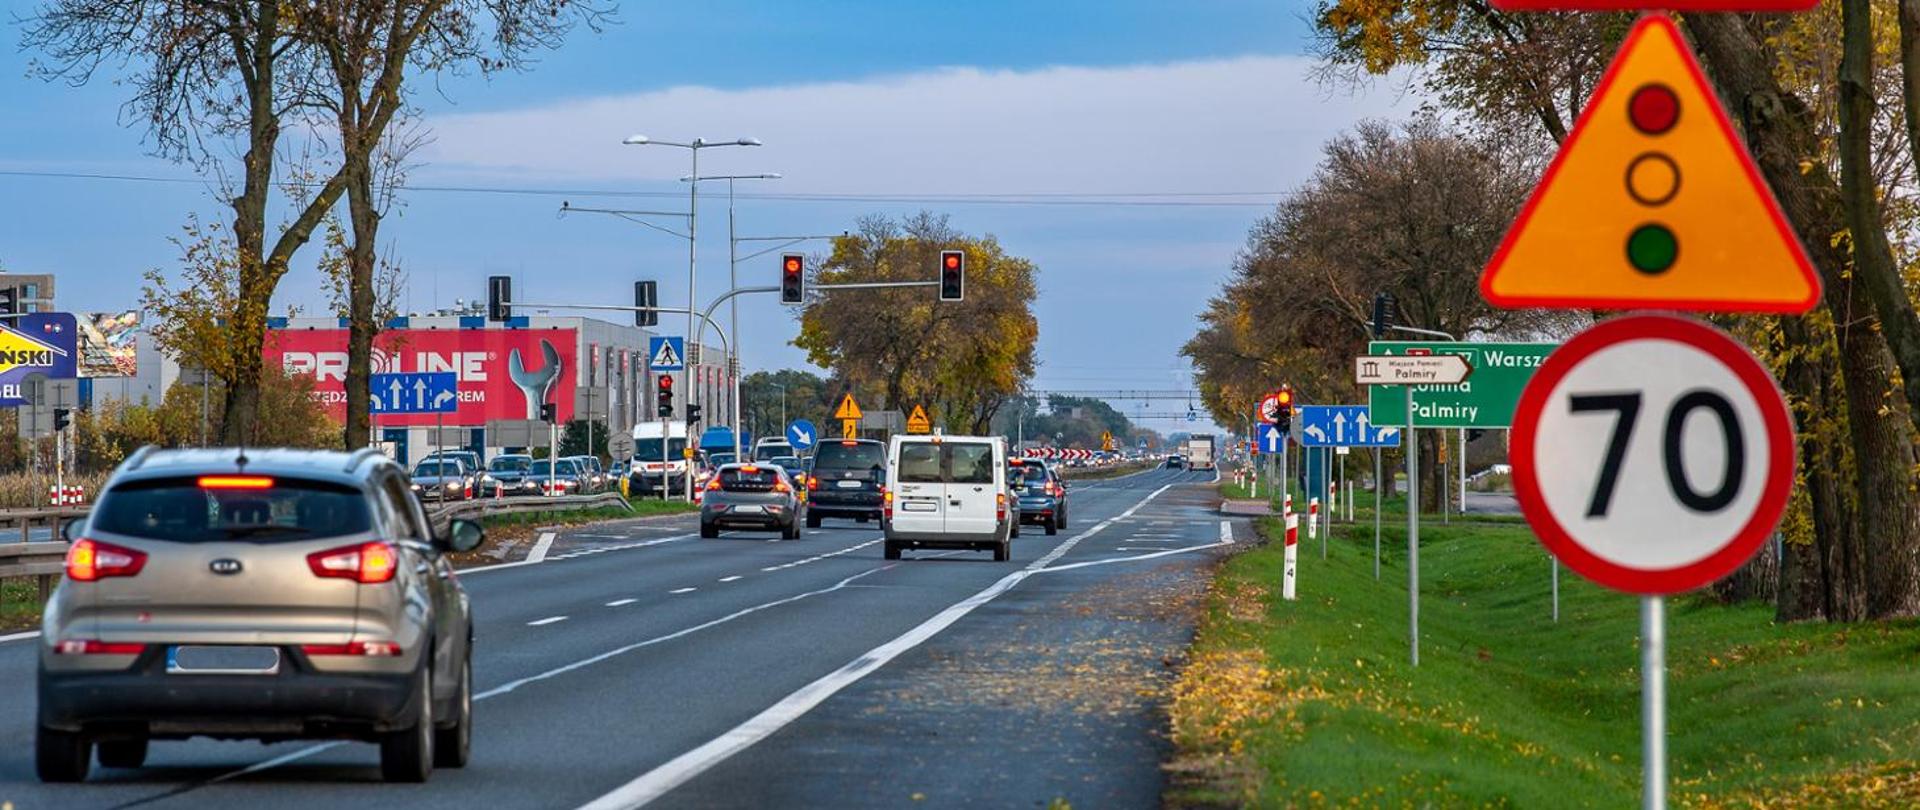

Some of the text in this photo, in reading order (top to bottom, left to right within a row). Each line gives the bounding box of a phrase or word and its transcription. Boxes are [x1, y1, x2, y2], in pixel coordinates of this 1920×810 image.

[1395, 369, 1437, 380] Palmiry
[1411, 401, 1478, 423] Palmiry
[1569, 390, 1746, 518] 70
[213, 562, 238, 571] KIA
[1287, 567, 1294, 577] 4
